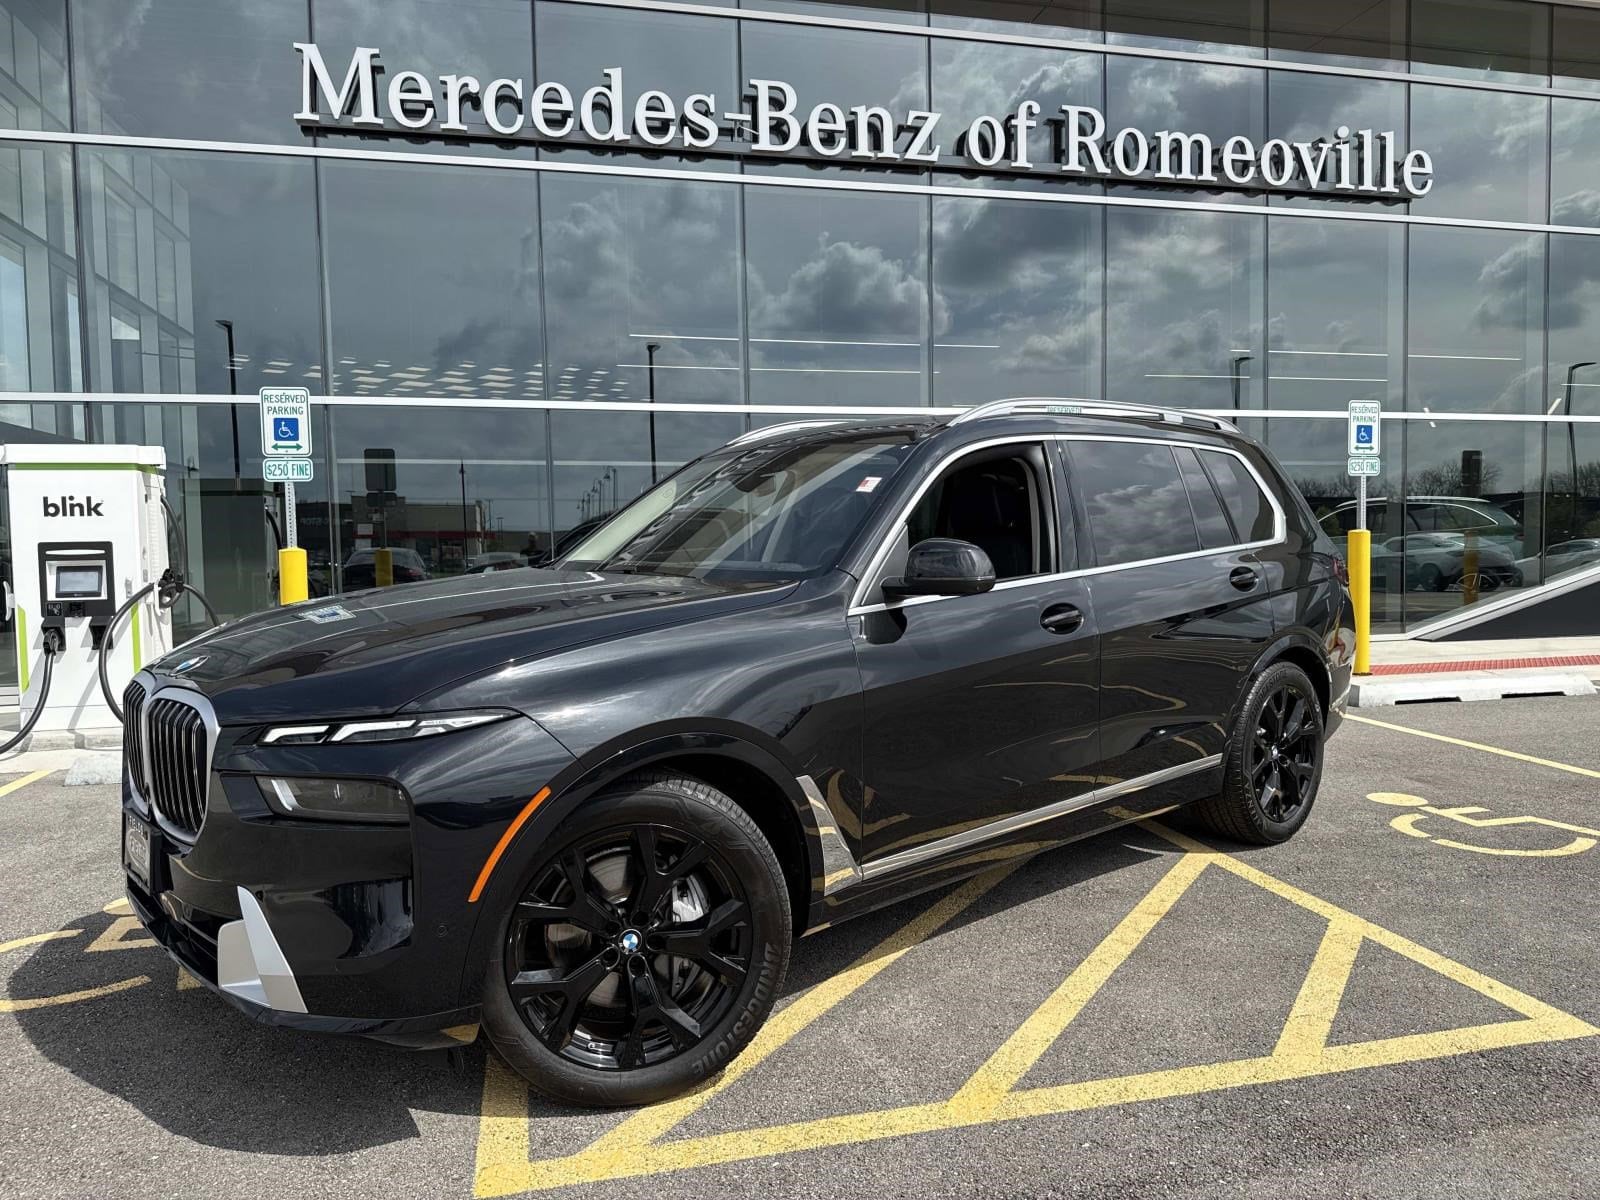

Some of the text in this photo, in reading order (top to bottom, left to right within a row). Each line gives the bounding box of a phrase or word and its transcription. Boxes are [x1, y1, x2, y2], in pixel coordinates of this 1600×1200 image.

[293, 41, 1434, 196] Mercedes-Benz of Romeoville
[263, 395, 306, 404] RESERVED
[267, 407, 304, 415] PARKING
[1351, 406, 1378, 414] RESERVED
[267, 464, 309, 476] $250 FINE
[1350, 462, 1378, 472] $250 FINE
[42, 495, 105, 518] blink
[690, 941, 783, 1076] BRIDGESTONE
